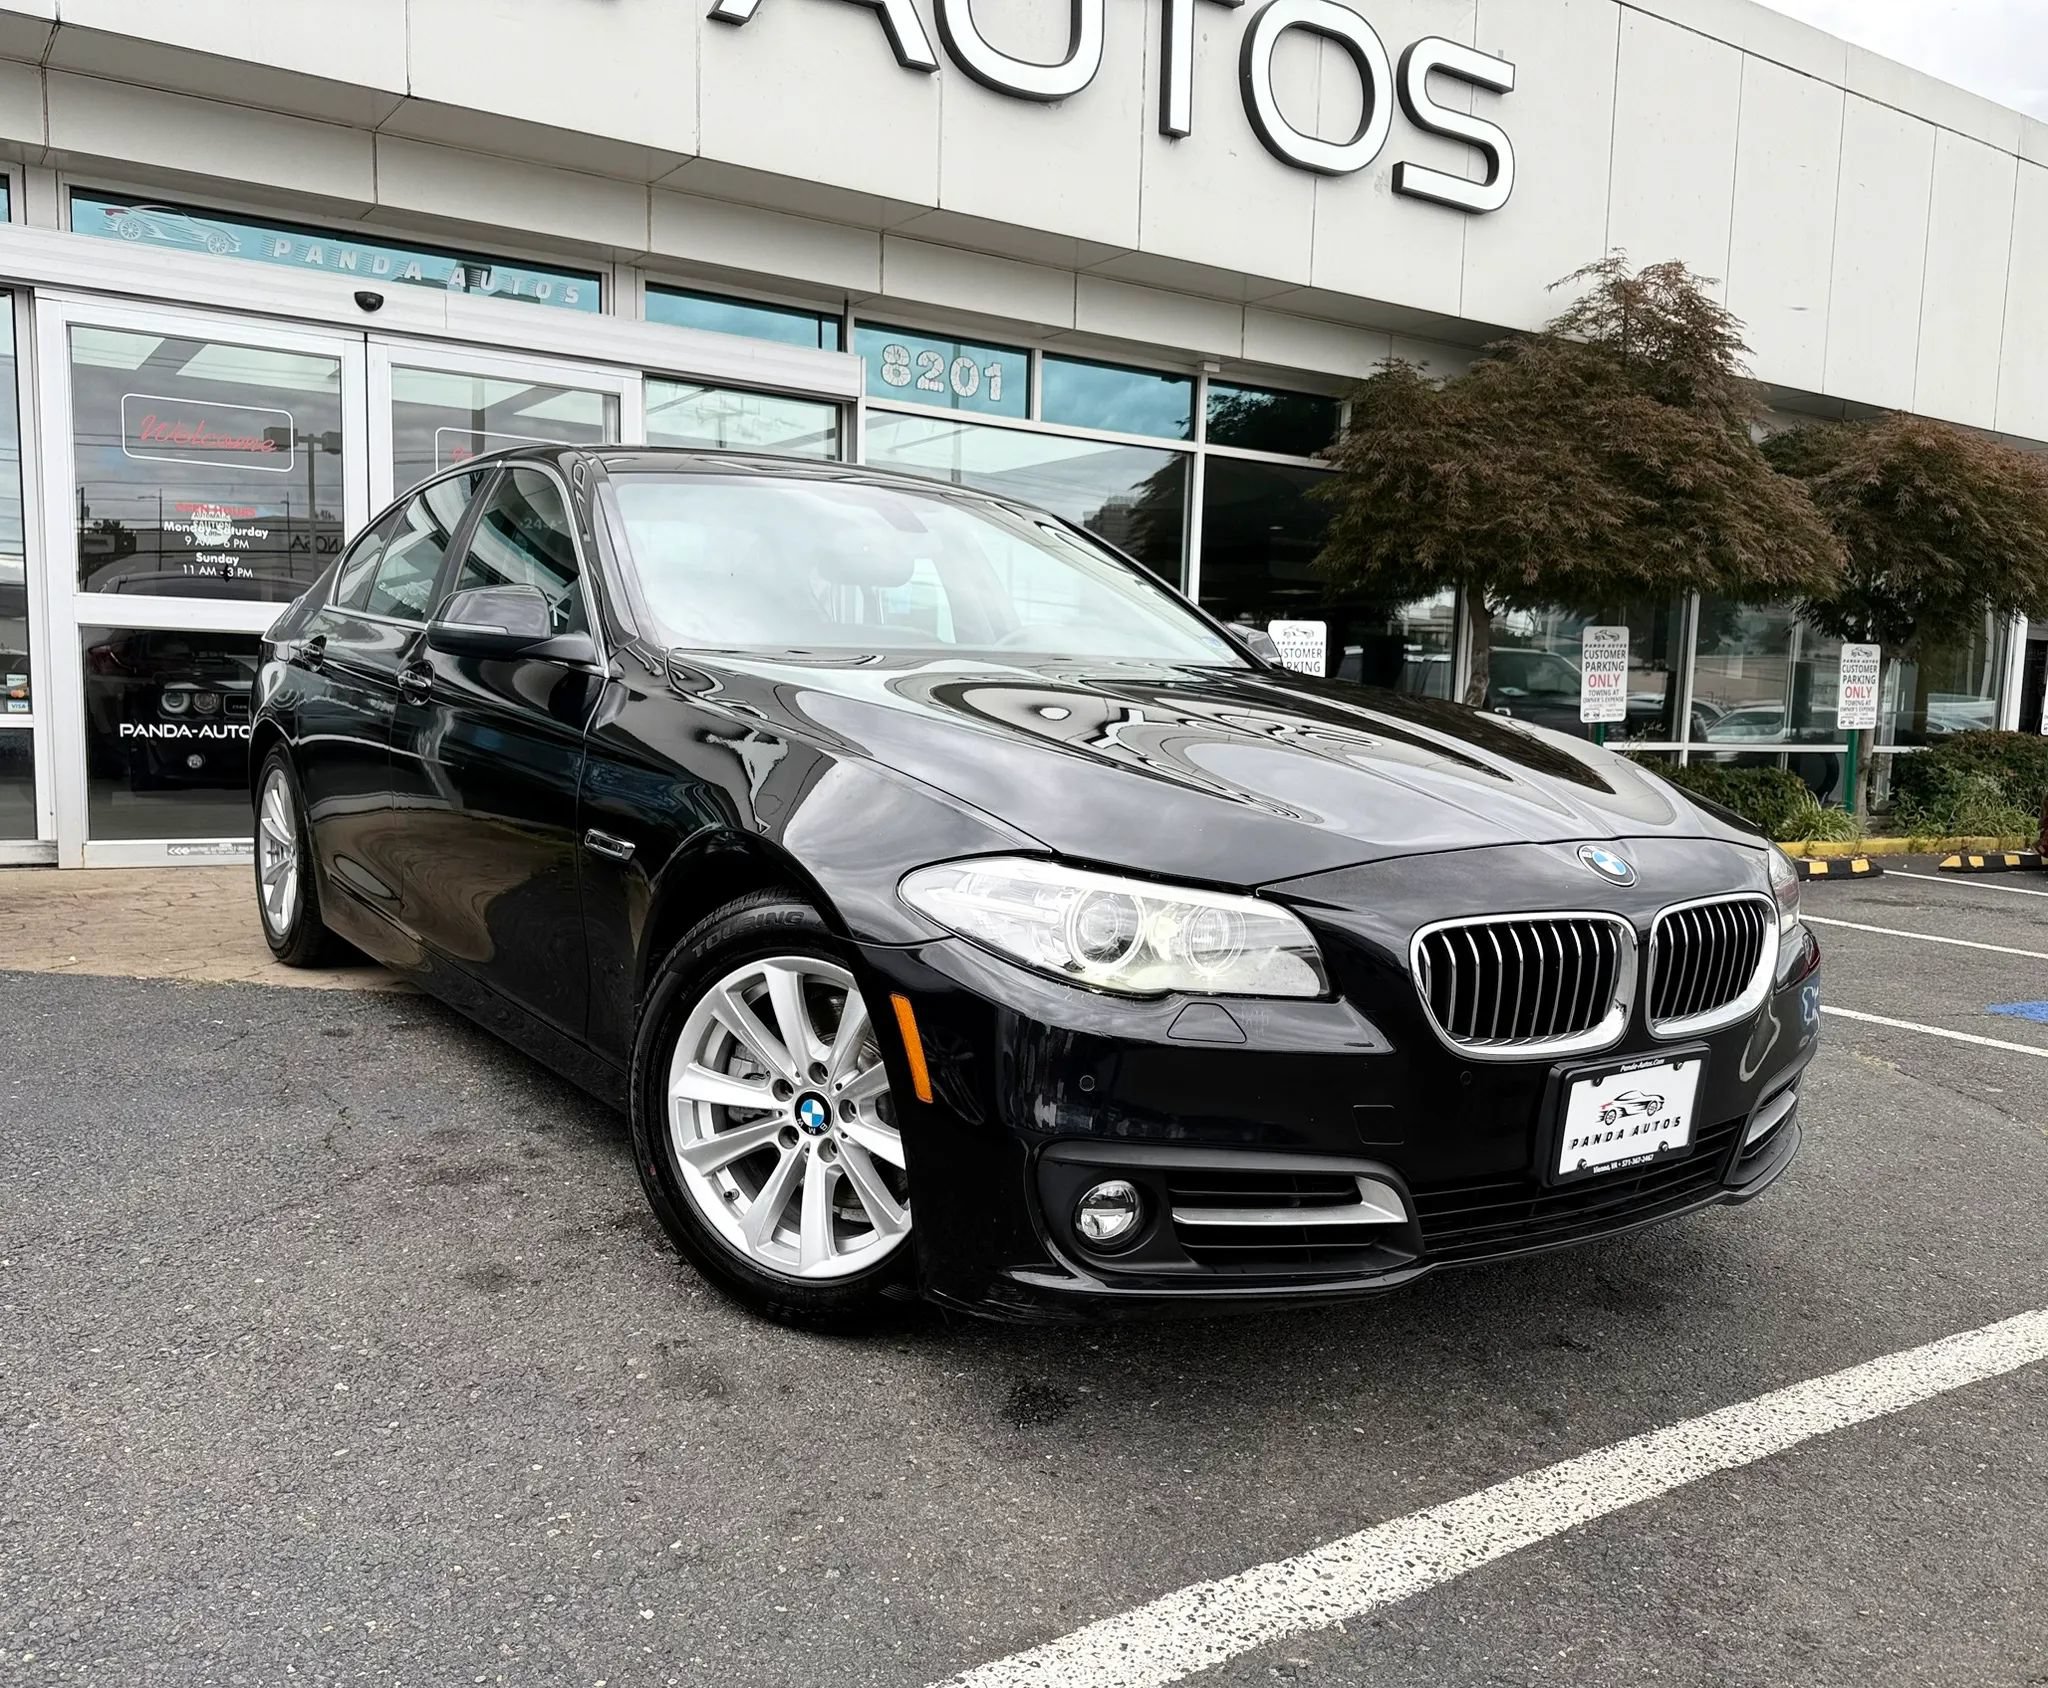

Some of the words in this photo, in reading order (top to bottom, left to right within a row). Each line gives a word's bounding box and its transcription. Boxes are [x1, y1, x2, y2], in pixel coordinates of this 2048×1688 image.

[706, 0, 1517, 213] UTOS
[266, 236, 422, 281] PANDA
[445, 262, 580, 304] AUTOS
[881, 343, 1002, 402] 8201
[140, 415, 277, 453] Welcome
[163, 521, 269, 539] Monday-Saturday
[184, 535, 192, 546] 9
[223, 538, 231, 548] 6
[233, 539, 250, 549] PM
[195, 552, 240, 567] Sunday
[183, 564, 195, 575] 11
[198, 565, 217, 576] AM
[227, 567, 234, 577] 3
[237, 568, 254, 578] PM
[1583, 649, 1626, 660] CUSTOMER
[1585, 661, 1625, 673] PARKING
[1842, 664, 1878, 674] CUSTOMER
[1588, 674, 1621, 688] ONLY
[1842, 675, 1876, 685] PARKING
[1588, 689, 1612, 697] TOWING
[1844, 686, 1873, 699] ONLY
[692, 911, 804, 958] TOURING
[796, 1117, 828, 1135] BMW
[1570, 1128, 1625, 1150] PANDA
[1631, 1116, 1682, 1137] AUTOS
